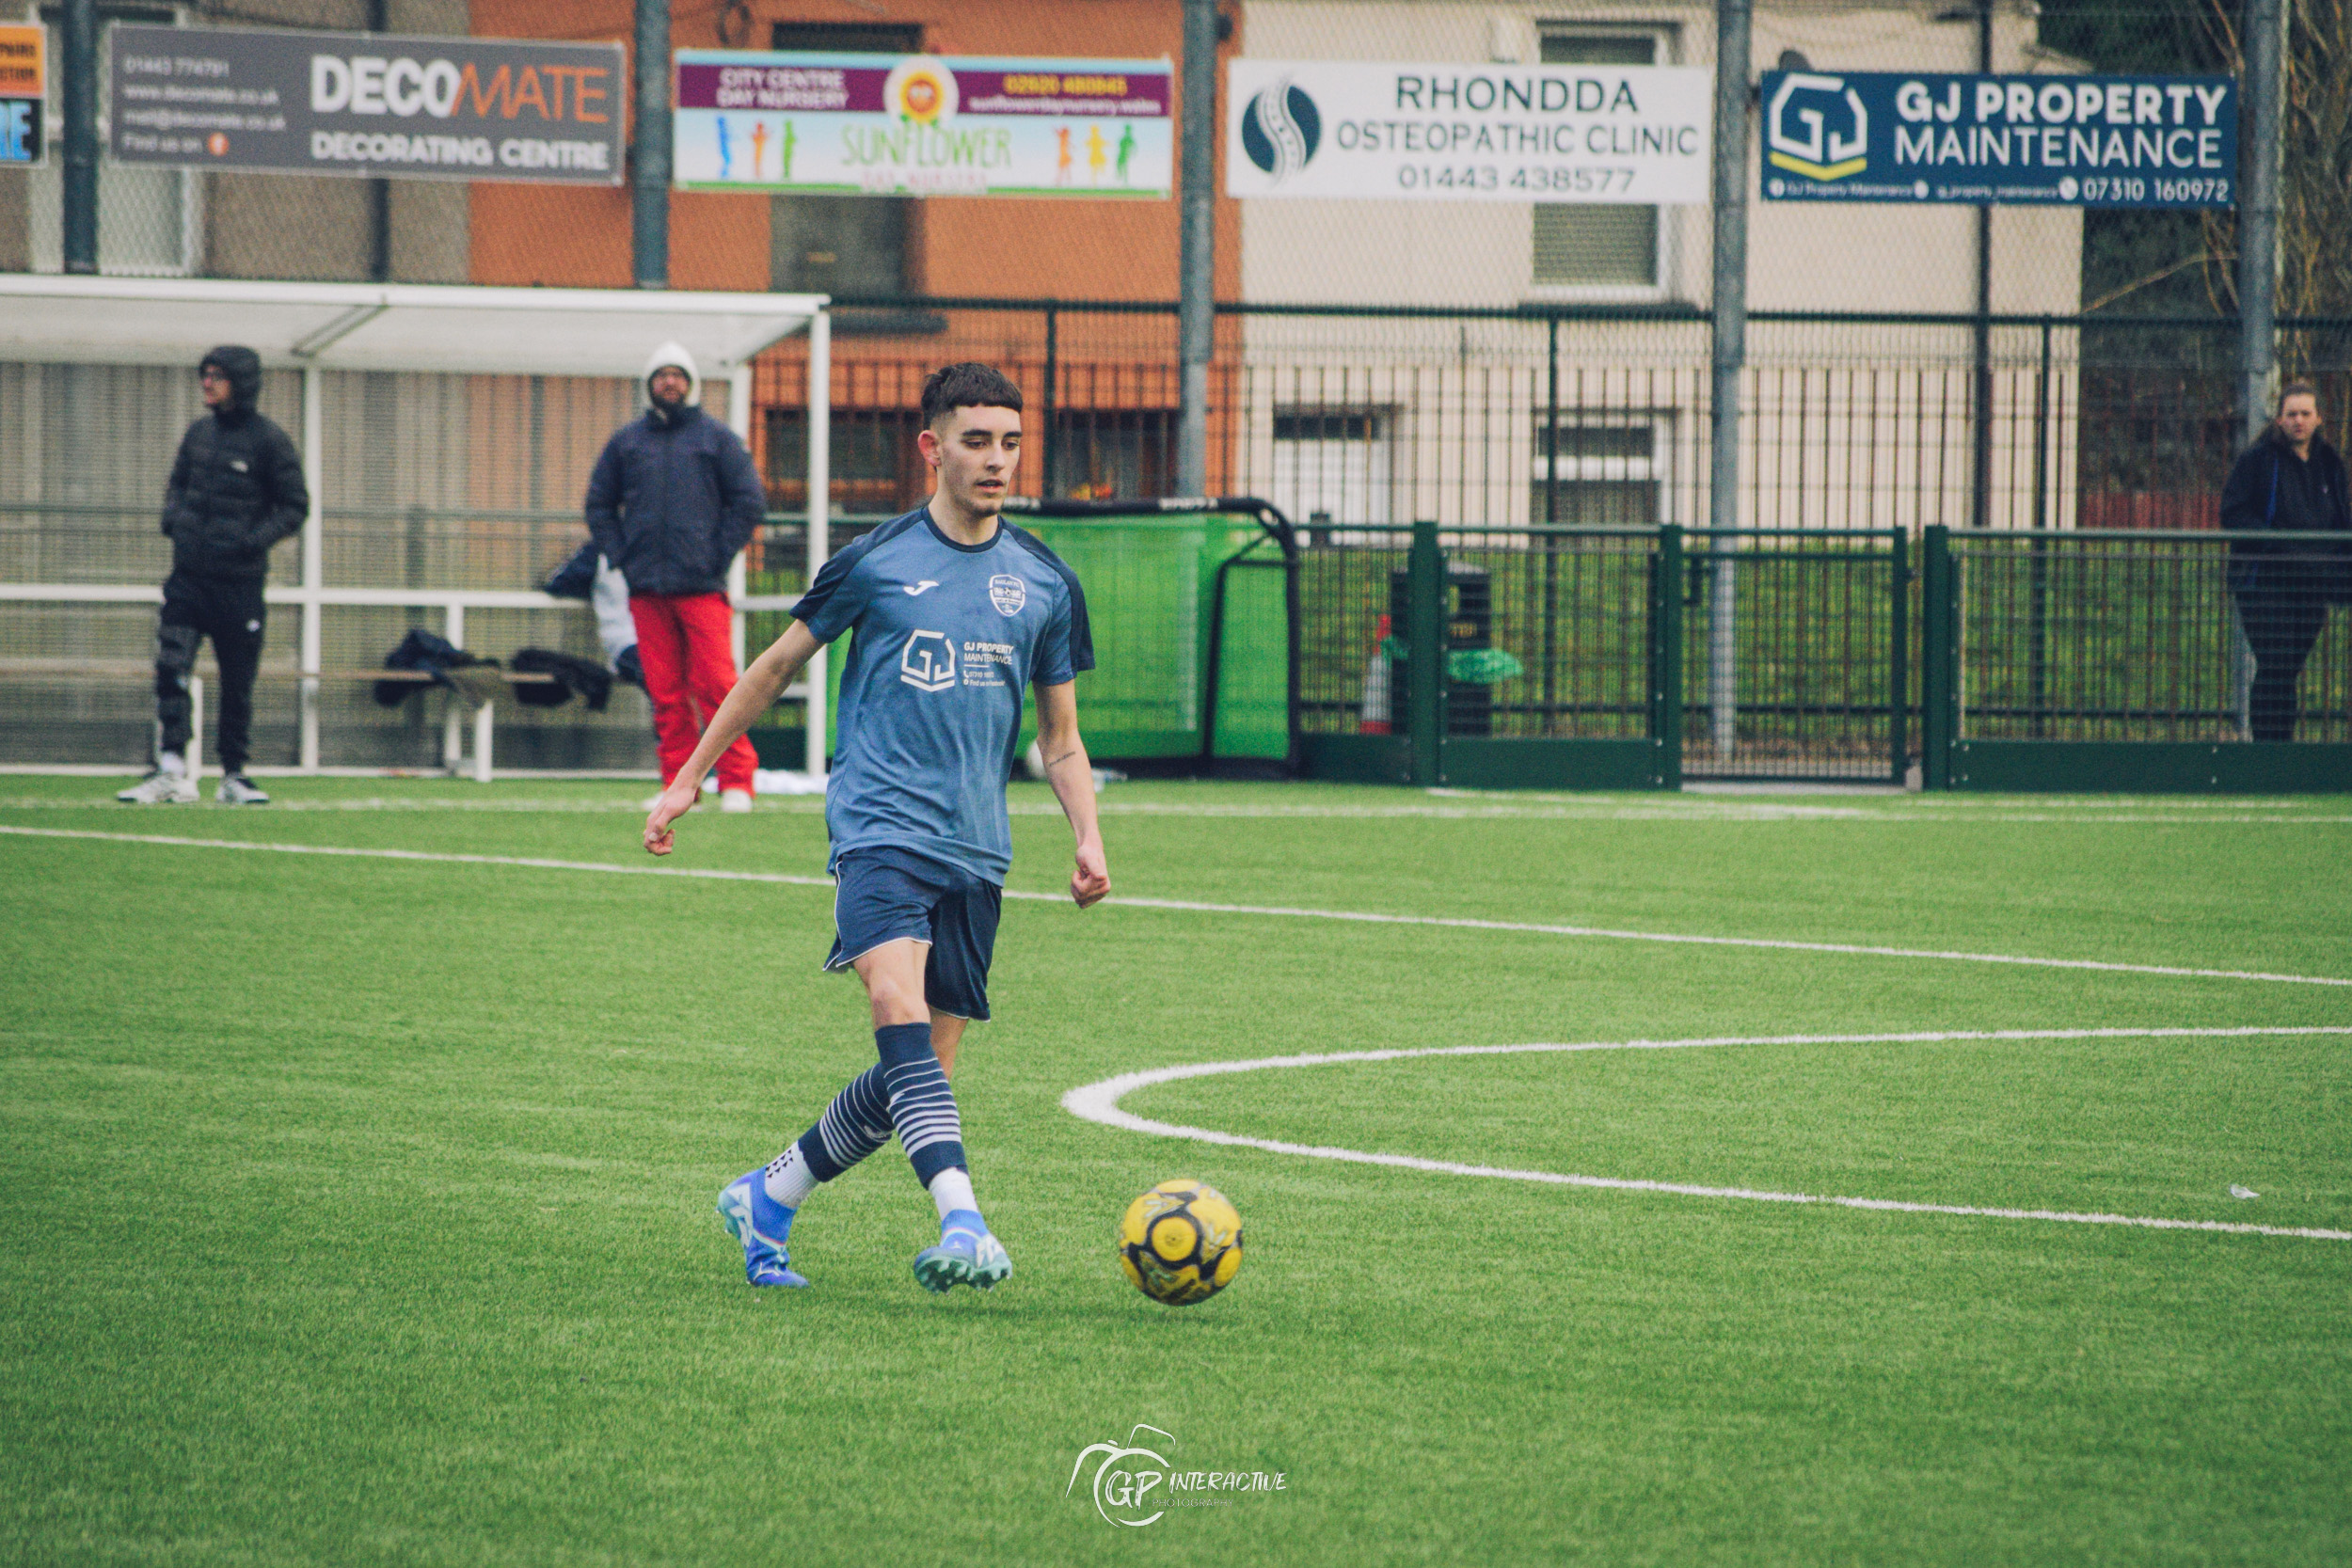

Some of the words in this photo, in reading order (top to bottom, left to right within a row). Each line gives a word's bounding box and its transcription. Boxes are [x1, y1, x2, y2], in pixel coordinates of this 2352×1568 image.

[310, 55, 610, 123] DECOMATE
[719, 67, 764, 87] CITY
[766, 69, 845, 89] CENTRE
[1396, 74, 1639, 114] RHONDDA
[1896, 81, 1962, 123] GJ
[1977, 83, 2228, 125] PROPERTY
[311, 131, 494, 166] DECORATING
[499, 138, 610, 170] CENTRE
[841, 124, 1012, 168] SUNFLOWER
[1338, 119, 1576, 155] OSTEOPATHIC
[1587, 124, 1699, 157] CLINIC
[1895, 125, 2224, 169] MAINTENANCE
[1399, 165, 1500, 190] 01443
[1510, 166, 1636, 194] 438577
[2082, 176, 2145, 201] 07310
[2153, 177, 2229, 202] 160972
[964, 641, 975, 651] GJ
[977, 642, 1014, 655] PROPERTY
[964, 653, 1012, 665] MAINTENANCE
